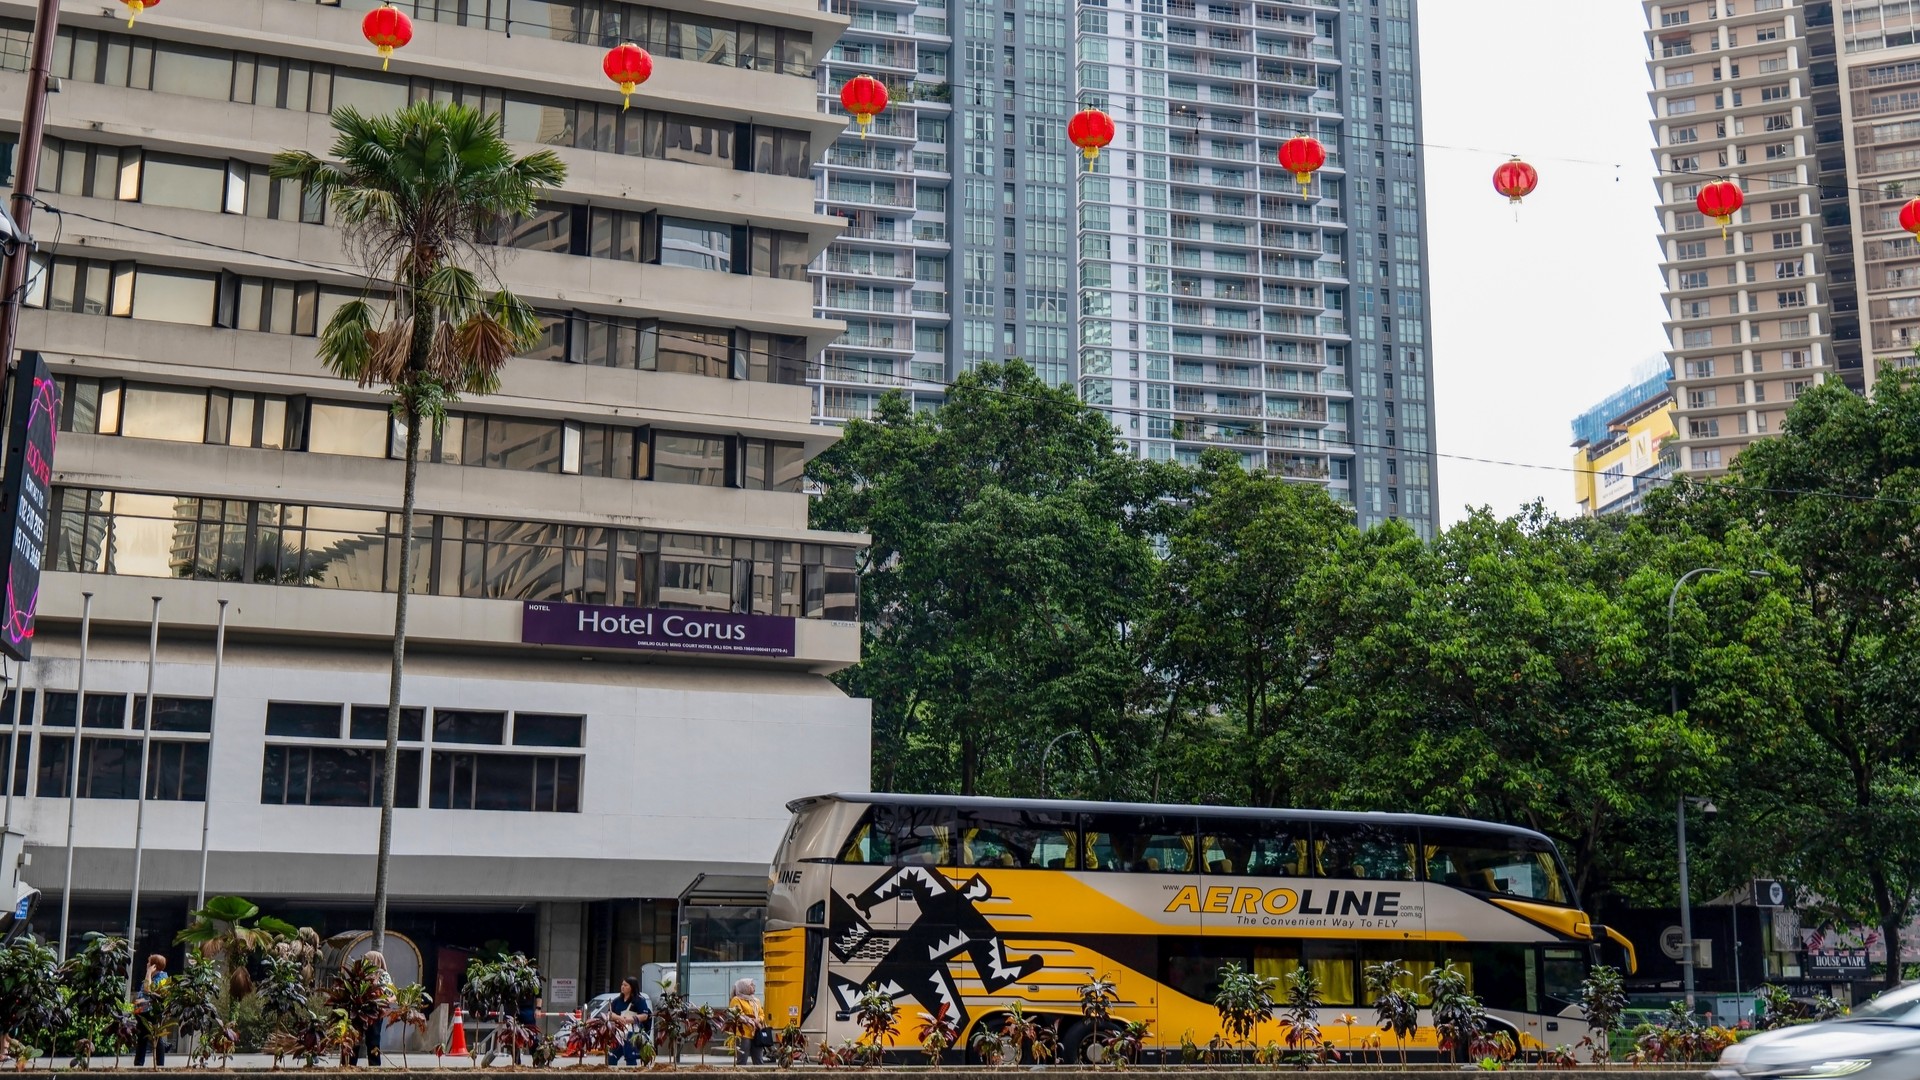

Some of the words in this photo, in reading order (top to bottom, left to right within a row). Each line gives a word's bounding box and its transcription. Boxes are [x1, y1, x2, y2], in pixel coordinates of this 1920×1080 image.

[528, 604, 550, 612] HOTEL
[578, 610, 653, 635] Hotel
[662, 615, 746, 640] Corus
[1163, 885, 1401, 917] AEROLINE
[1236, 915, 1257, 925] The
[1262, 916, 1327, 926] Convenient
[1332, 918, 1355, 928] Way
[1360, 918, 1372, 928] To
[1377, 919, 1398, 928] FLY
[1815, 956, 1841, 967] HOUSE
[1847, 956, 1866, 967] VAPE
